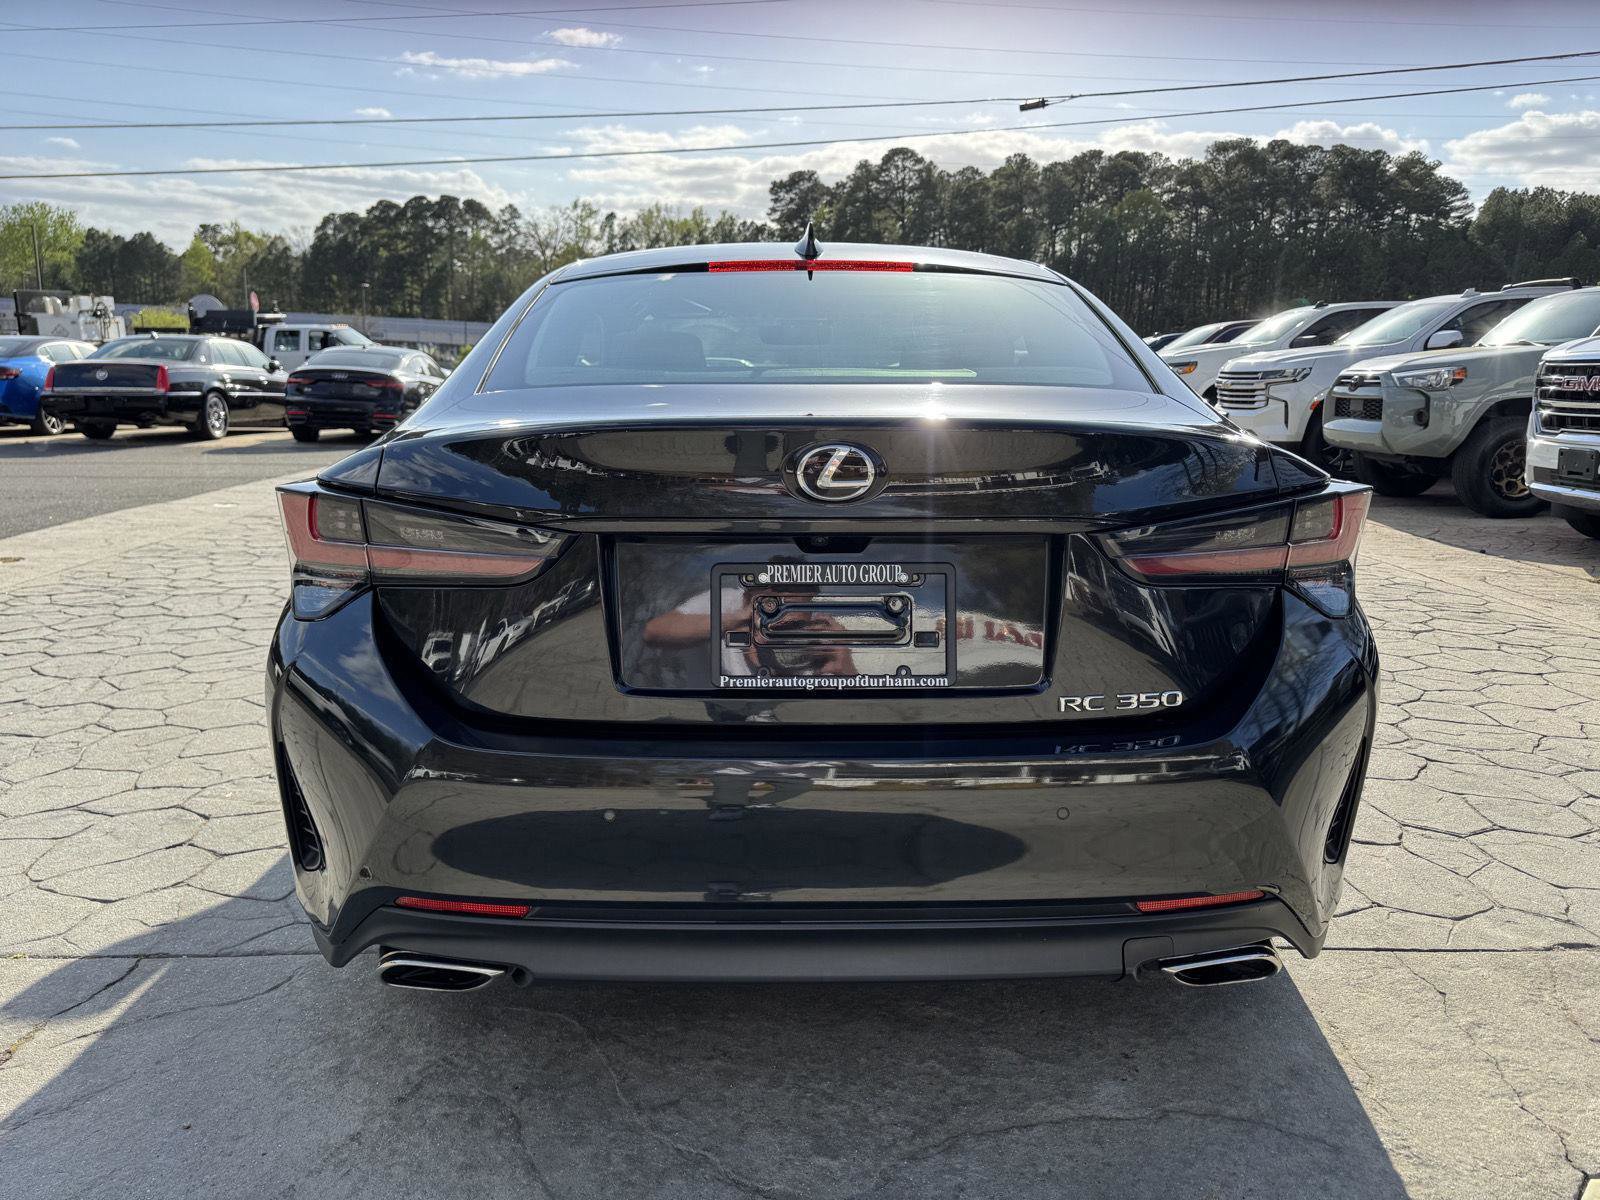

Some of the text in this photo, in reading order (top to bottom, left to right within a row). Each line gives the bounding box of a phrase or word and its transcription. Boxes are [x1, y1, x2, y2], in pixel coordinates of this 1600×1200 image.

[1561, 375, 1600, 391] GM
[767, 564, 903, 583] PREMIER AUTO GROUP
[719, 675, 949, 690] Premierautogroupofdurham.com
[1059, 690, 1183, 712] RC 350
